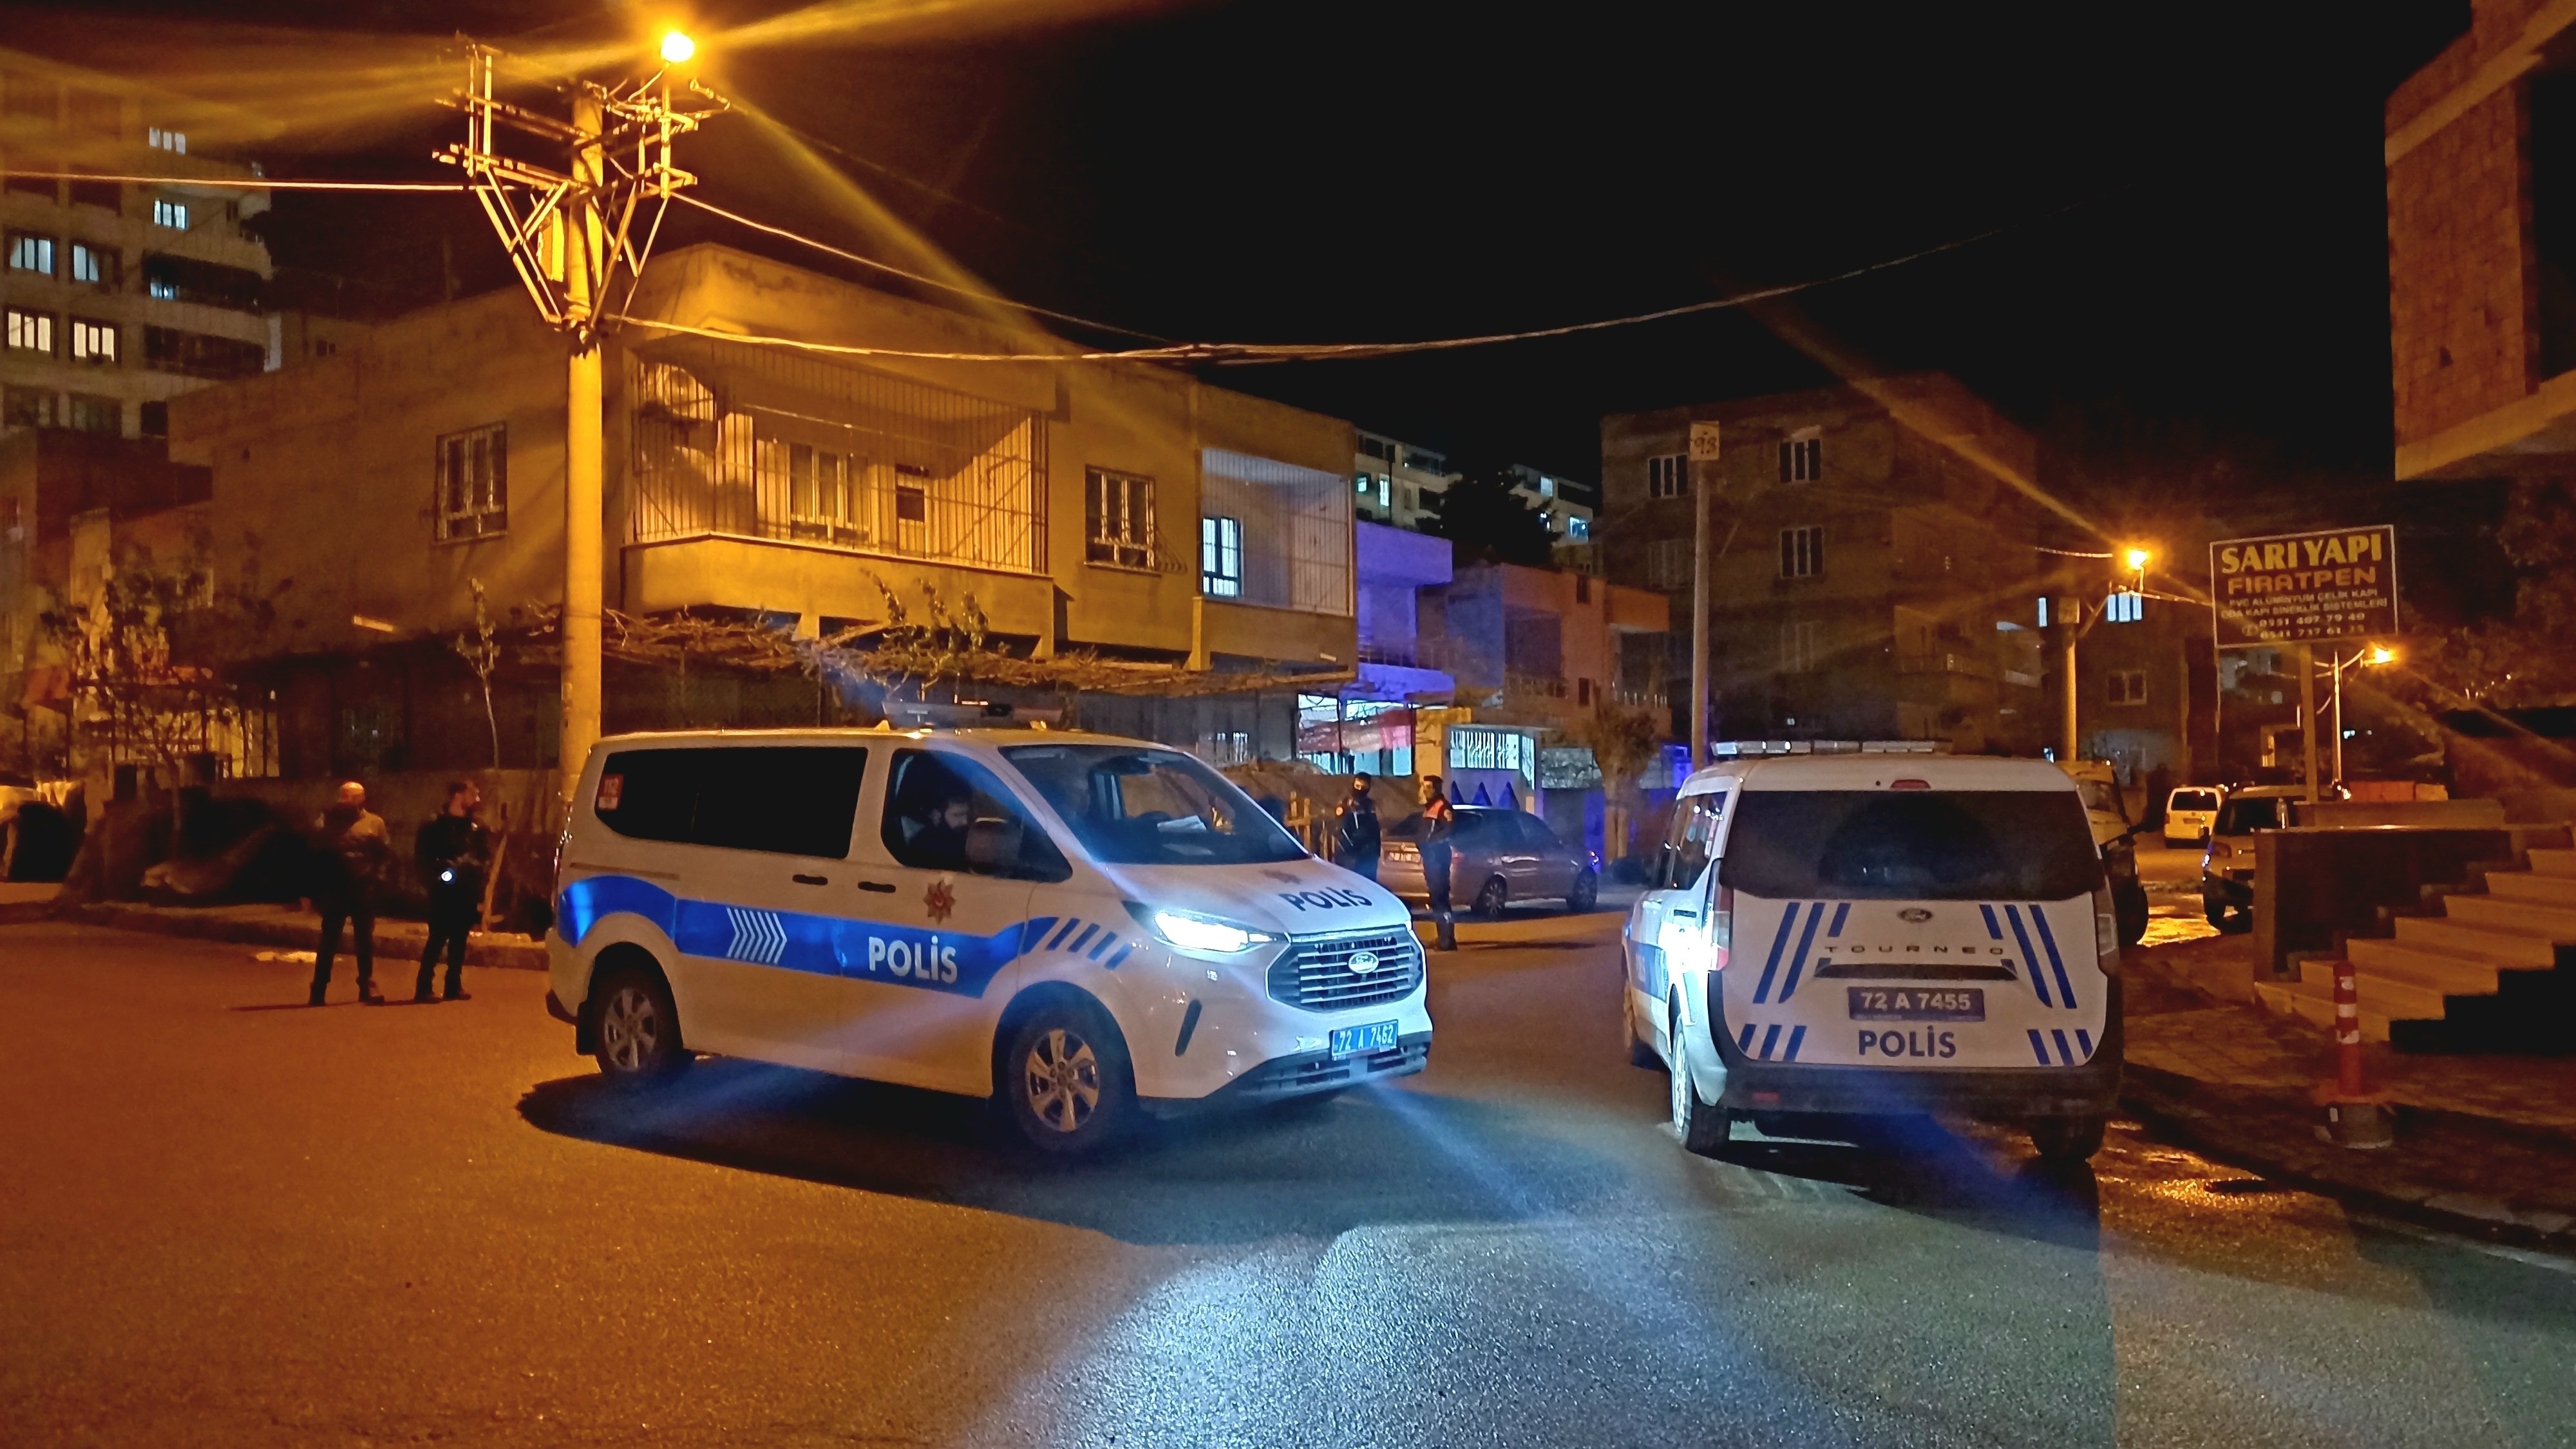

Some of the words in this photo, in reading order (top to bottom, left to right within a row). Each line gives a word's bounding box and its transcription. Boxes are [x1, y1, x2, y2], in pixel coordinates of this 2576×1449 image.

[2222, 542, 2298, 573] SARI
[2304, 533, 2382, 566] YAPI
[2228, 567, 2376, 594] FIRATPEN
[1278, 887, 1372, 911] POLİS
[869, 935, 958, 984] POLİS
[1824, 945, 2003, 955] TOURNEO
[1861, 992, 1888, 1010] 72
[1895, 992, 1911, 1009] A
[1917, 992, 1971, 1010] 7455
[1339, 1030, 1352, 1052] 72
[1358, 1028, 1364, 1049] A
[1859, 1025, 1956, 1058] POLİS
